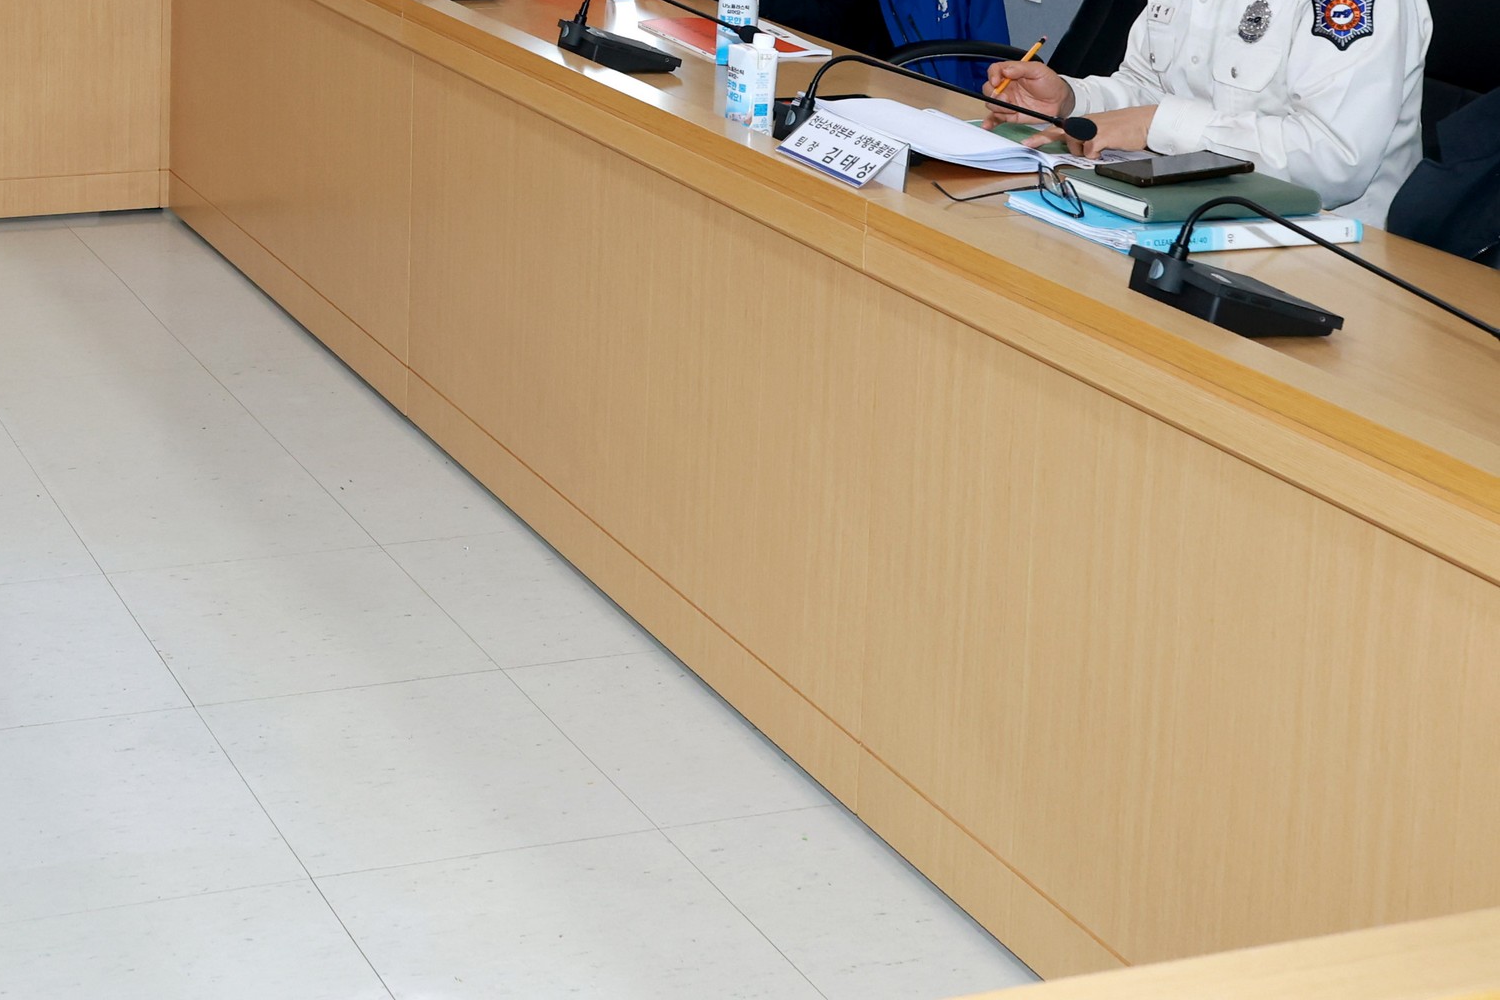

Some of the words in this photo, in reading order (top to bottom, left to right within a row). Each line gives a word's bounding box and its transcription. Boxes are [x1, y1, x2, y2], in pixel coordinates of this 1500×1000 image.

[808, 115, 857, 141] 전남소방본부
[854, 133, 899, 160] 상황총괄팀
[1227, 233, 1235, 244] 40
